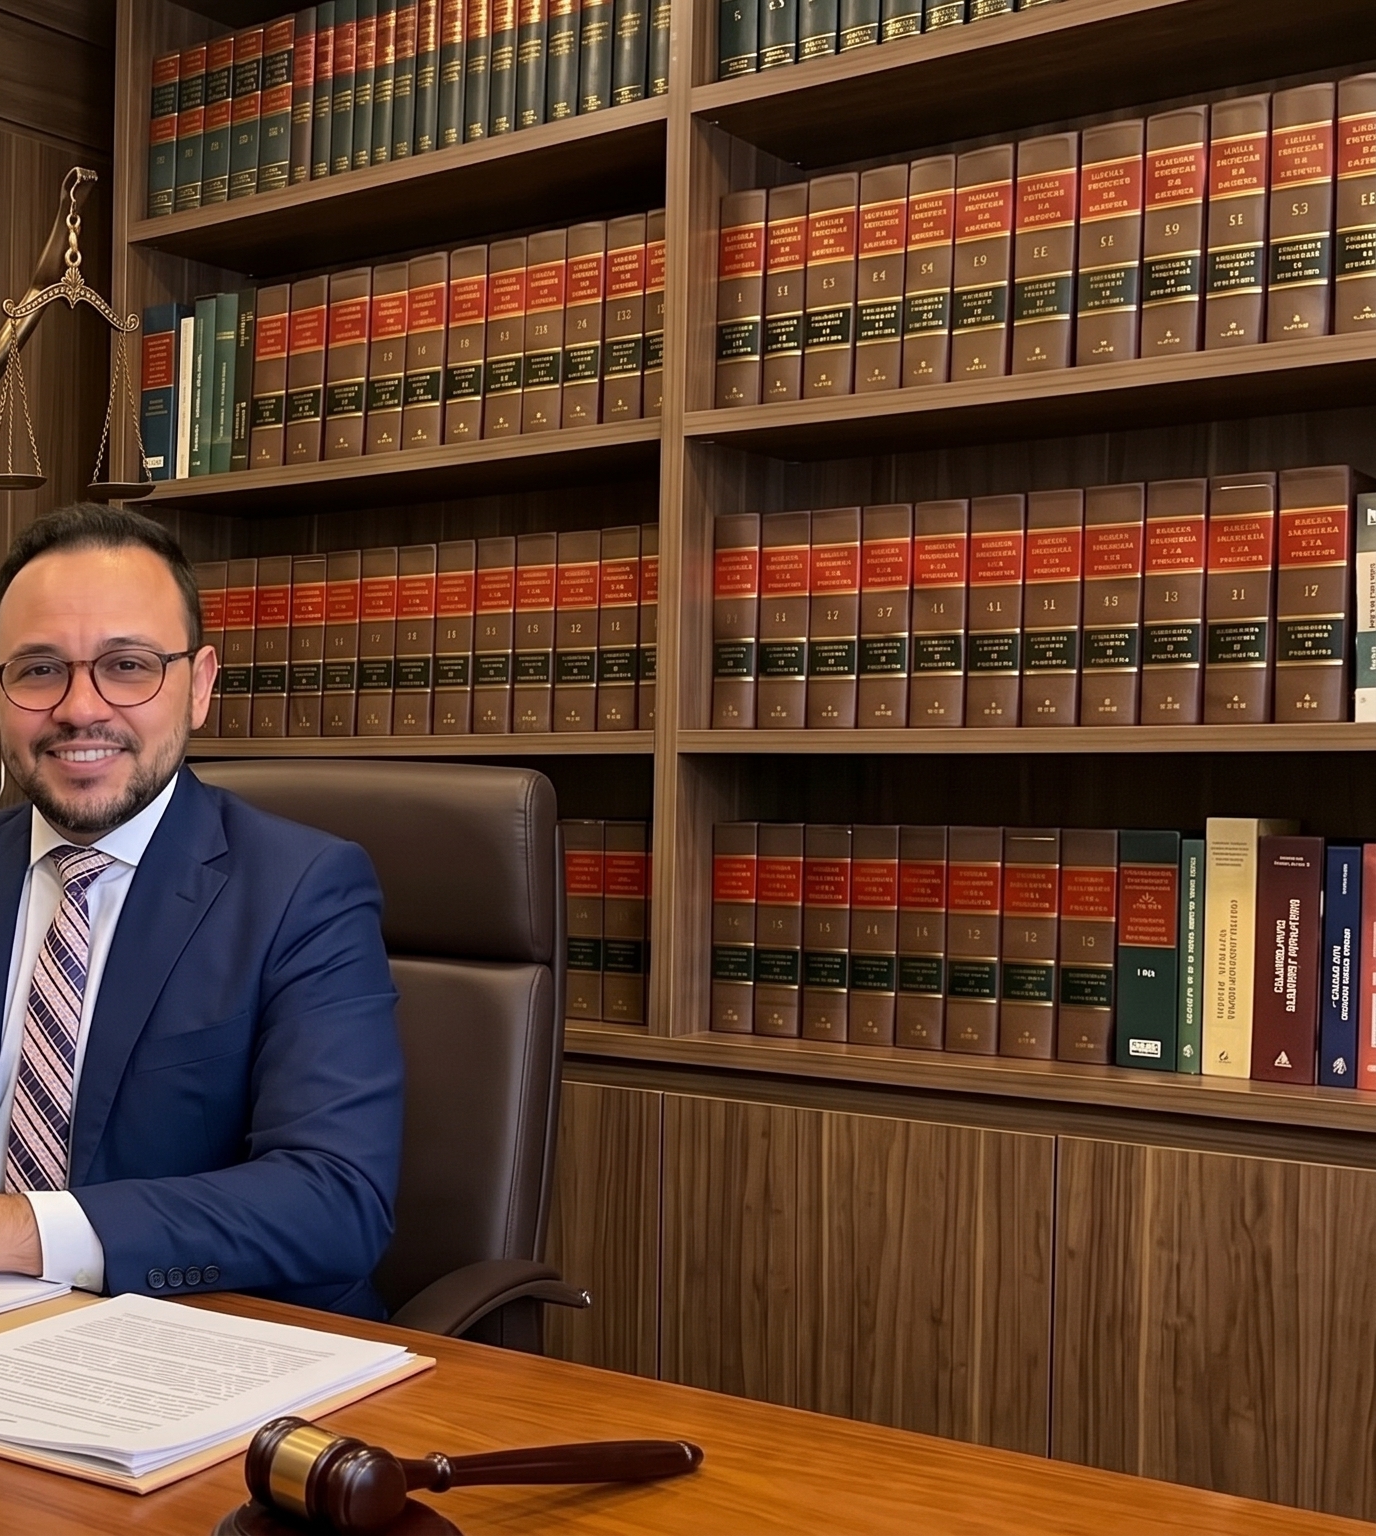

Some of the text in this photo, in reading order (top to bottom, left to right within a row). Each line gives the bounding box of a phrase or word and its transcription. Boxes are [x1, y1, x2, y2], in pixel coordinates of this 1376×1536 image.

[1165, 591, 1178, 602] 13
[878, 607, 893, 618] 37
[570, 623, 581, 633] 12
[968, 929, 980, 940] 12
[1025, 931, 1037, 942] 12
